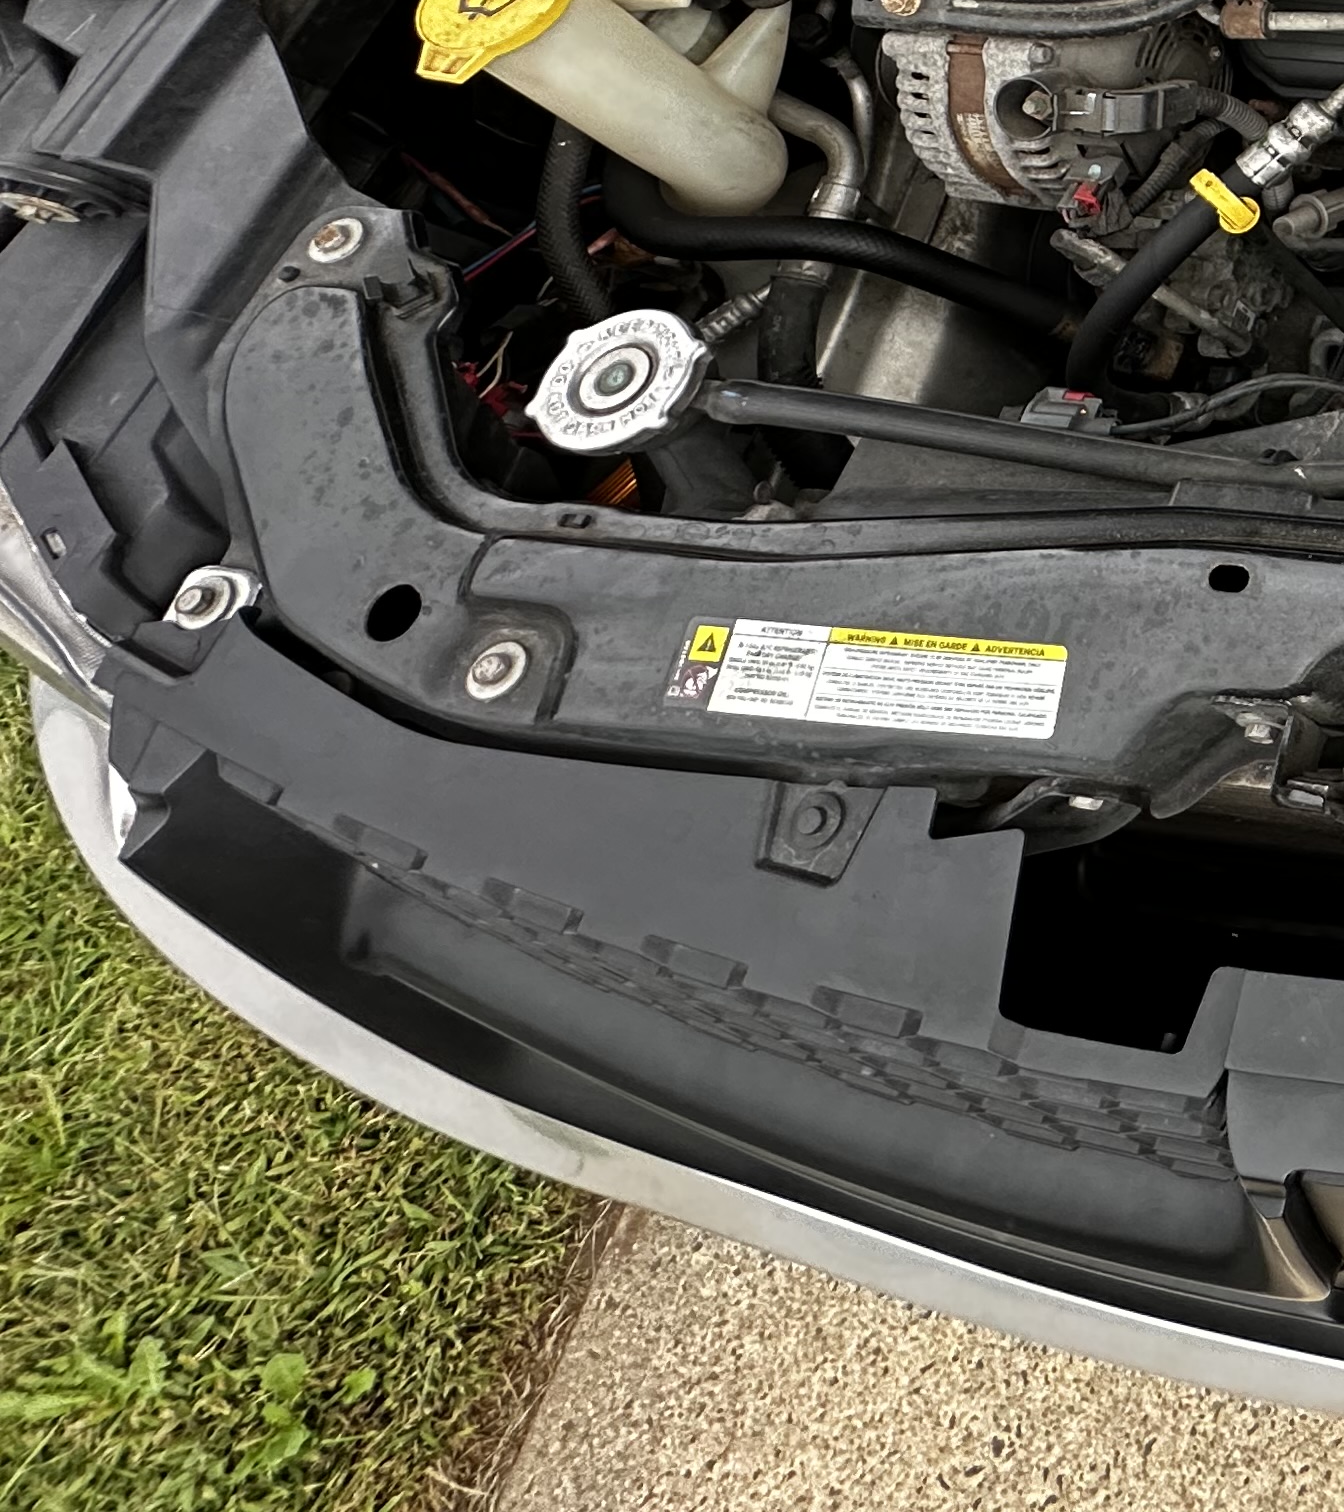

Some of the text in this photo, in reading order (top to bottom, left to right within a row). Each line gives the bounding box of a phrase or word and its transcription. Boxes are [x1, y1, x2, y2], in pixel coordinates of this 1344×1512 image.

[846, 633, 1045, 657] WARNING MISE EN GARDE ADVERTENCIA
